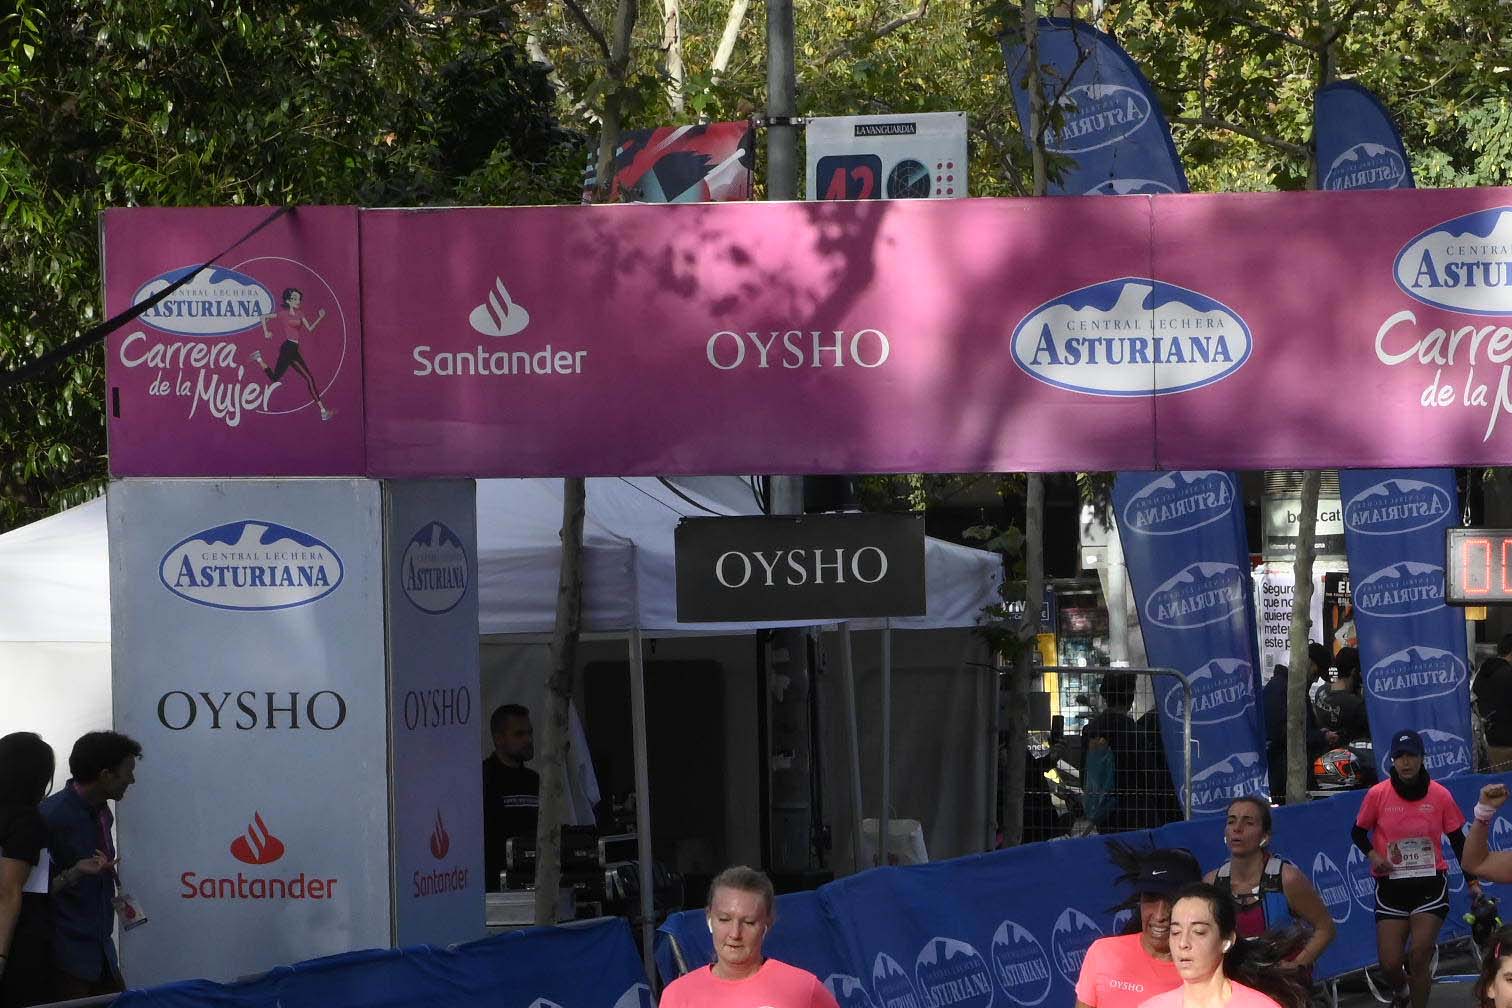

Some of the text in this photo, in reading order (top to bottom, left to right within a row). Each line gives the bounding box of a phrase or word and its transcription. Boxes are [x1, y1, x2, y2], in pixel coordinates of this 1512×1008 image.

[143, 289, 264, 318] ASTURIANA
[170, 288, 209, 297] ENTRAL
[1066, 317, 1226, 331] CENTRAL LECHERA
[119, 331, 238, 369] Carrera
[706, 328, 890, 371] OYSHO
[1029, 322, 1235, 367] ASTURIANA
[412, 344, 588, 378] Santander
[149, 366, 283, 427] de la Mujer
[1420, 368, 1456, 407] de
[1463, 367, 1488, 407] la
[1287, 508, 1341, 523] b.cat
[173, 554, 331, 588] ASTURIANA
[201, 552, 325, 561] CENTRAL LECHERA
[715, 545, 889, 589] OYSHO
[406, 559, 465, 591] ASTURIANA
[1263, 598, 1280, 609] que
[1264, 637, 1284, 648] este
[157, 690, 347, 731] OYSHO
[404, 685, 471, 731] OYSHO
[181, 871, 338, 899] Santander
[413, 867, 469, 898] Santander
[1000, 957, 1048, 987] ASTURIANA
[1109, 980, 1144, 993] OYSHO
